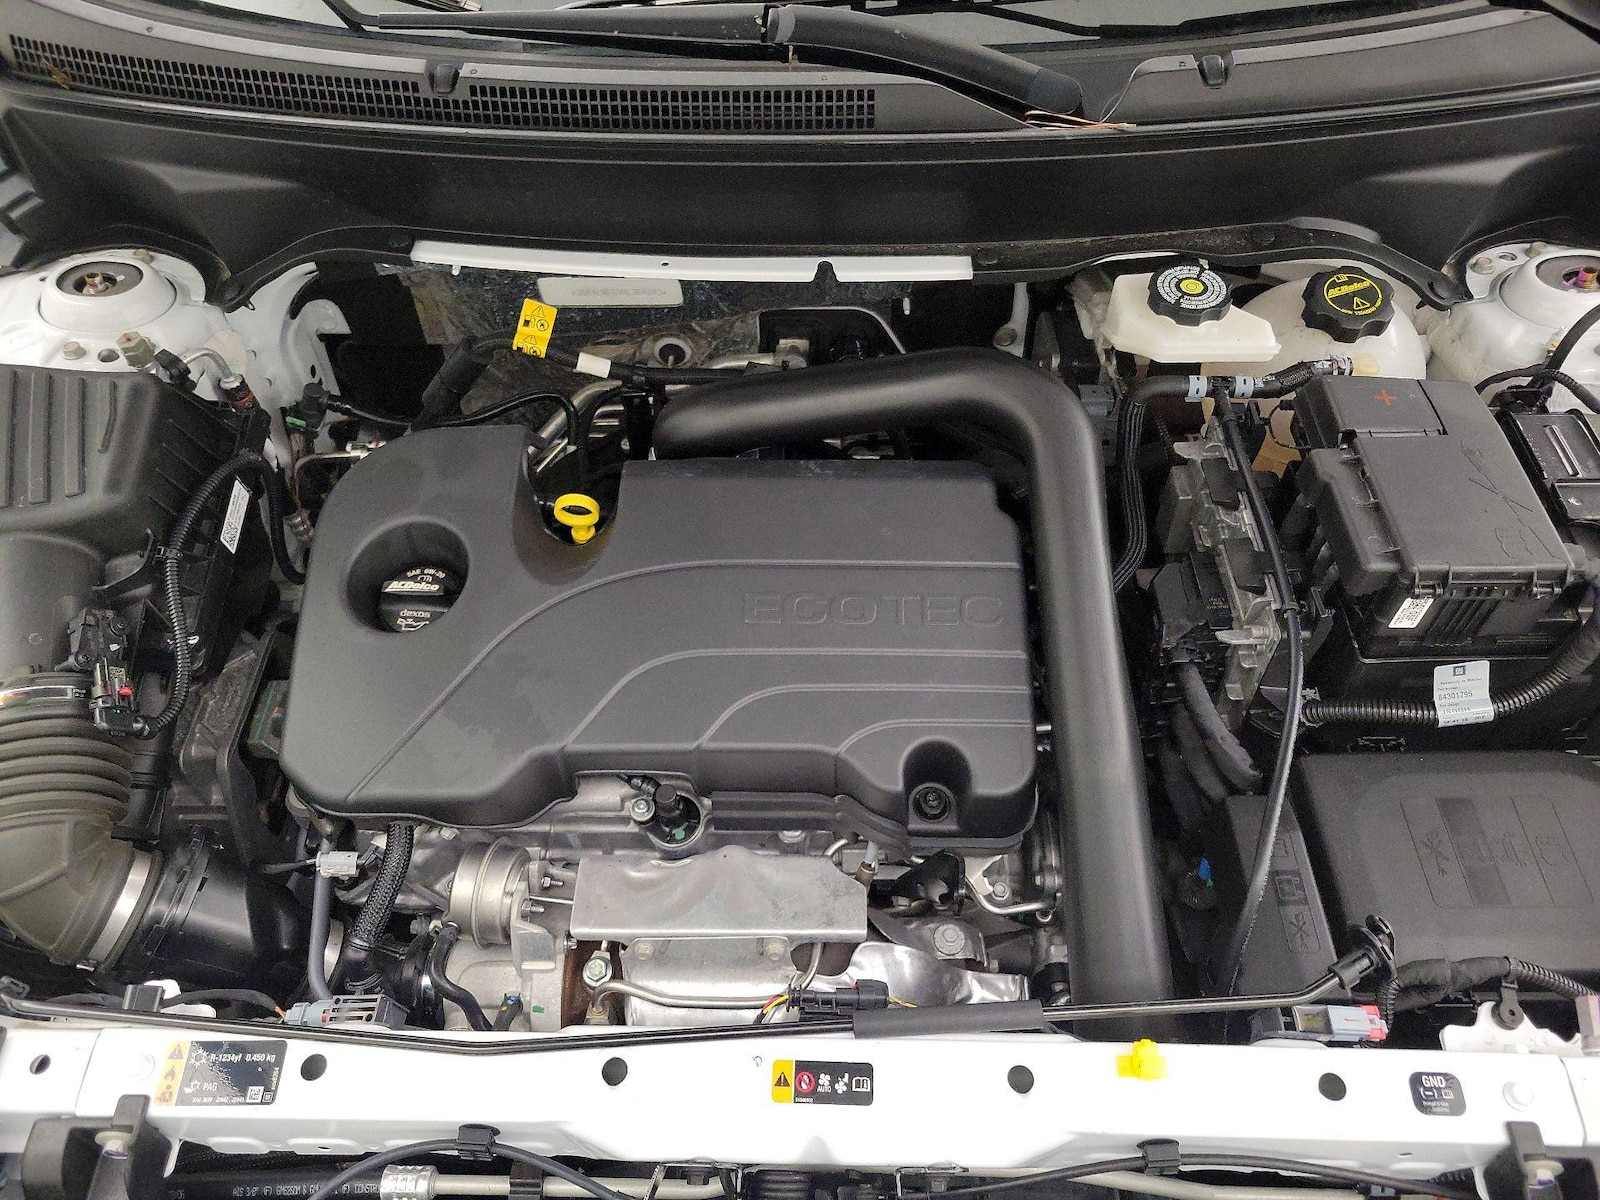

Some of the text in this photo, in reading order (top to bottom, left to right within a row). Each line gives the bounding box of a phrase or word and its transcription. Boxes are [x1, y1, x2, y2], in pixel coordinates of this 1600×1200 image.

[1328, 280, 1371, 297] ACDelco
[387, 581, 440, 592] ACDelco
[400, 609, 431, 618] dexos
[744, 593, 1003, 628] ECOTEC
[1438, 690, 1473, 700] 84301795
[210, 1053, 276, 1064] R-1234yf 0.450 kg
[1421, 1075, 1446, 1088] GND
